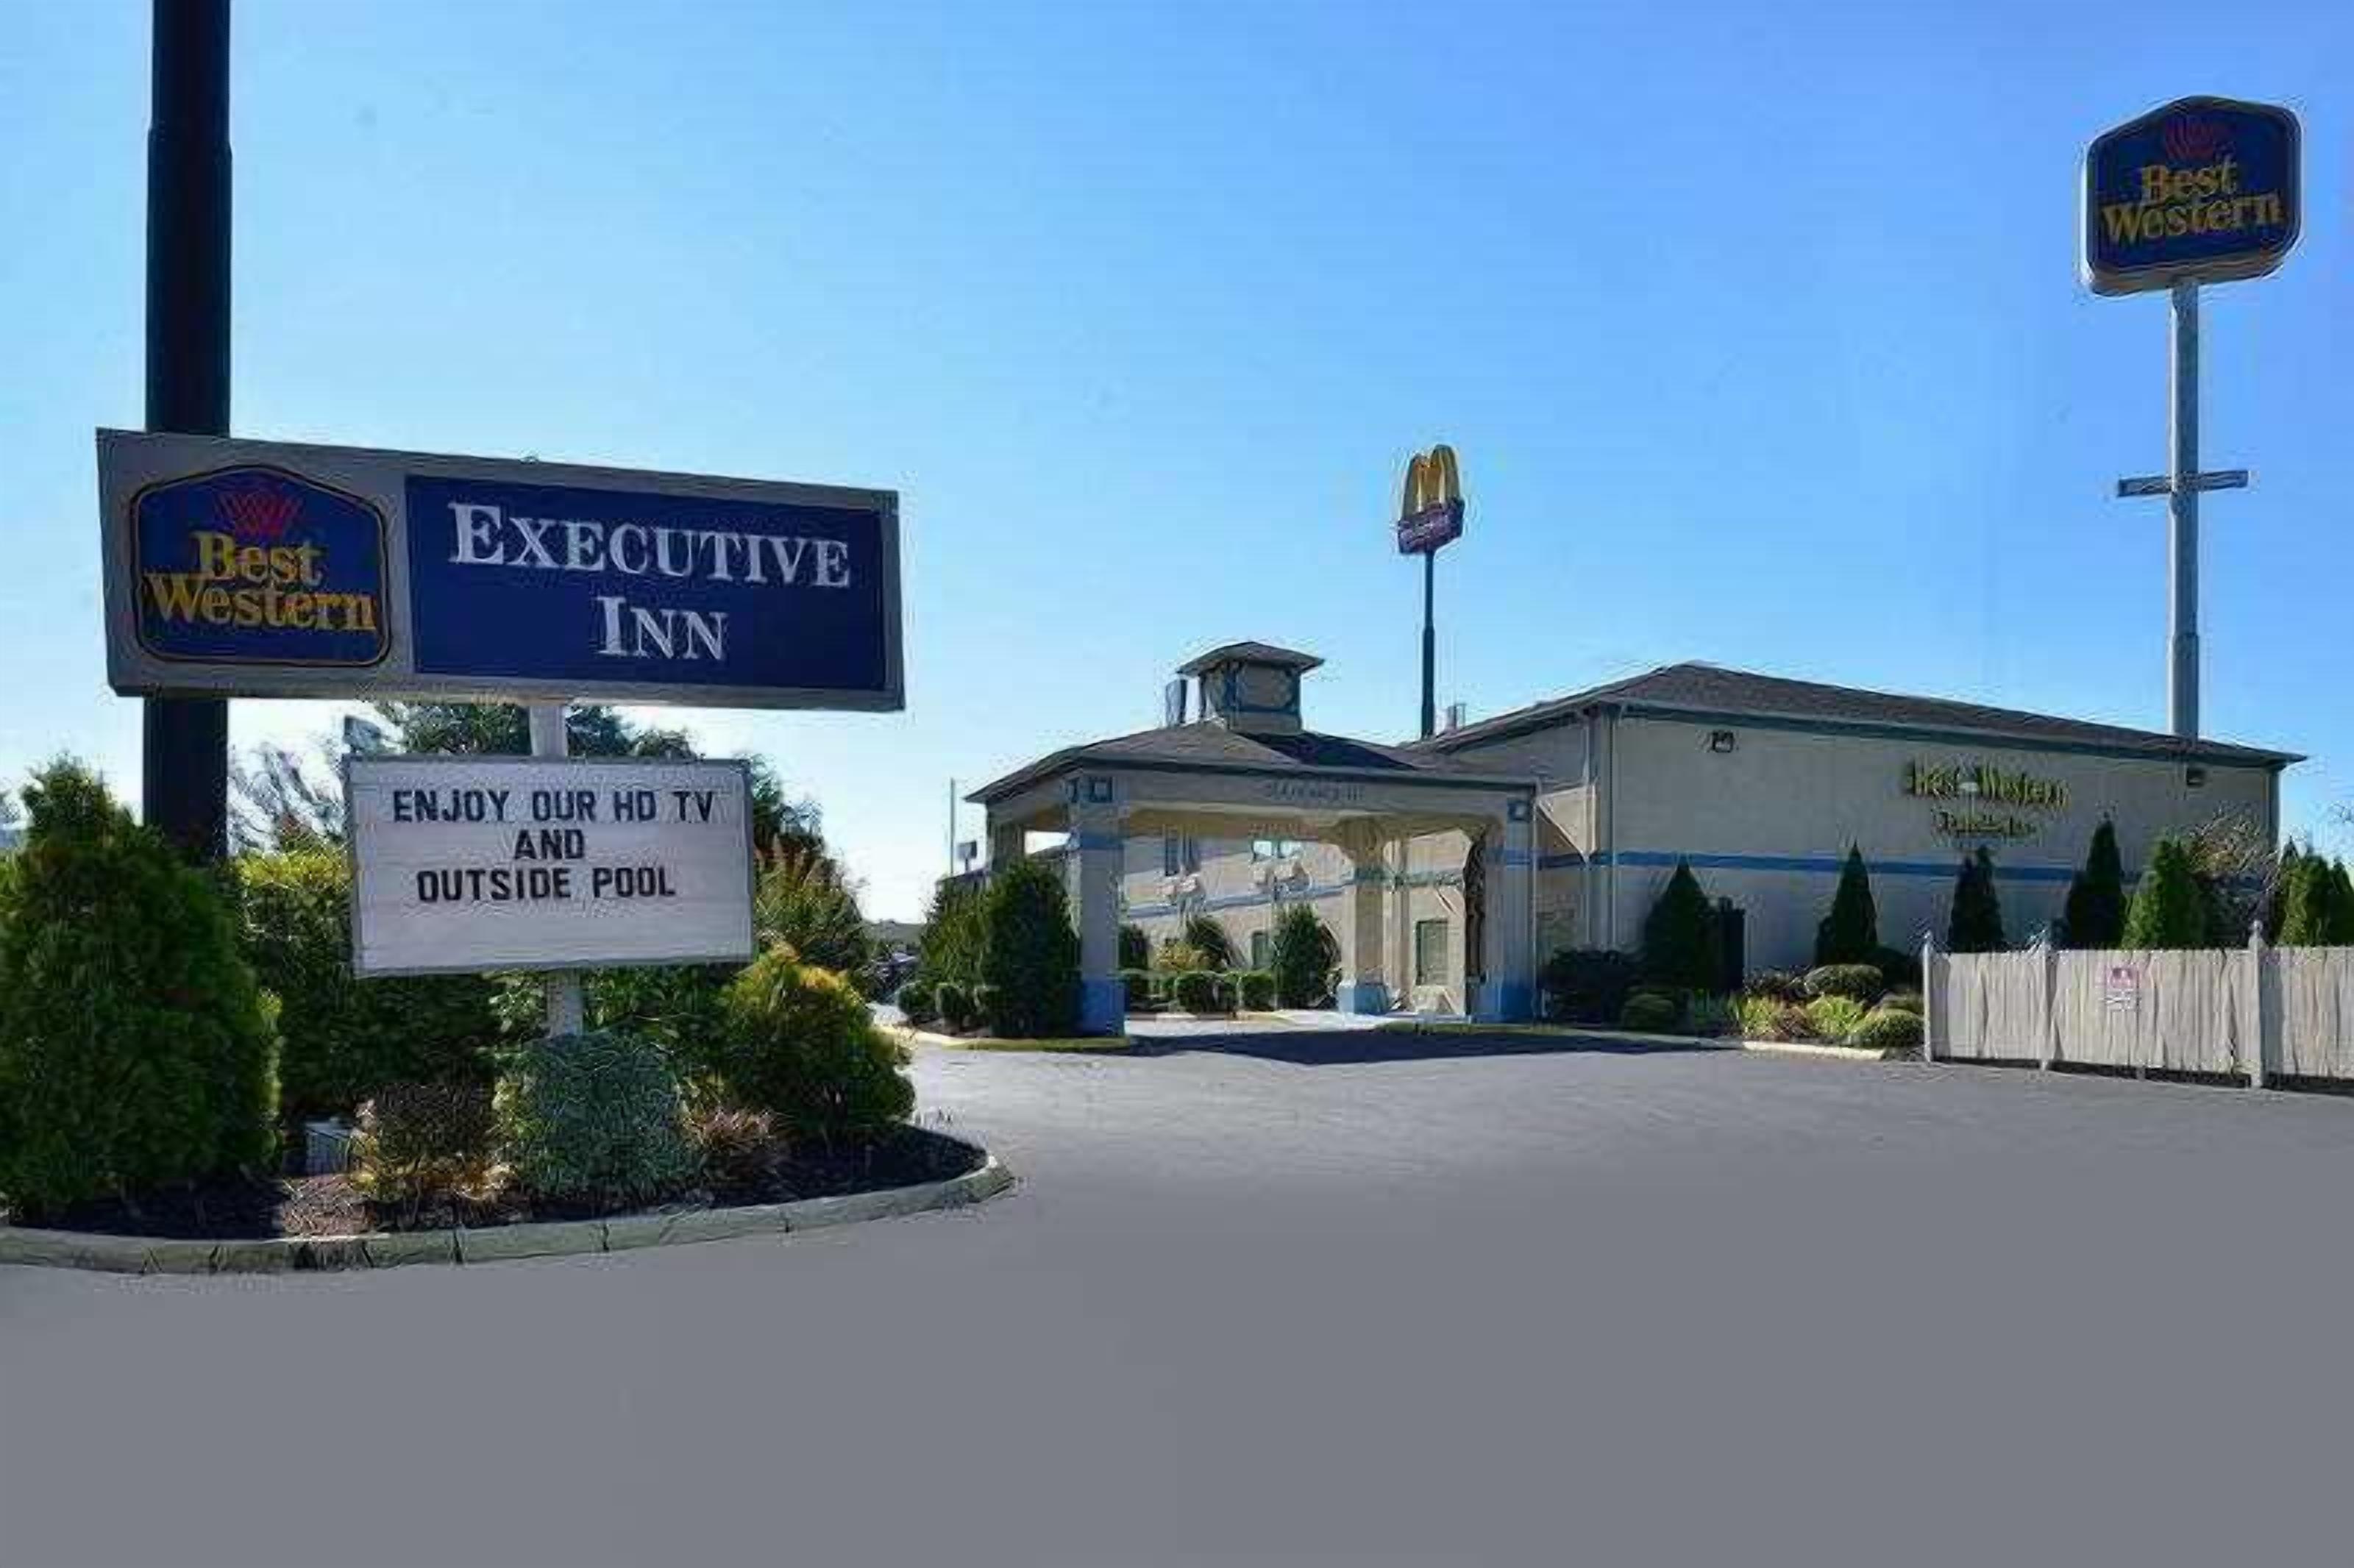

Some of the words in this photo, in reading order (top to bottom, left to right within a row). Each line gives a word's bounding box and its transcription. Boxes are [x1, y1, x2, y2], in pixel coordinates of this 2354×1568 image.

[2141, 153, 2237, 204] Best
[2102, 190, 2285, 243] Western
[190, 530, 324, 585] Best
[447, 502, 851, 587] EXECUTIVE
[144, 571, 376, 631] Western
[596, 596, 729, 660] INN
[393, 790, 509, 822] ENJOY
[533, 790, 596, 822] OUR
[614, 791, 656, 821] HD
[673, 791, 714, 822] TV
[514, 828, 586, 860] AND
[417, 867, 571, 902] OUTSIDE
[593, 866, 676, 898] POOL
